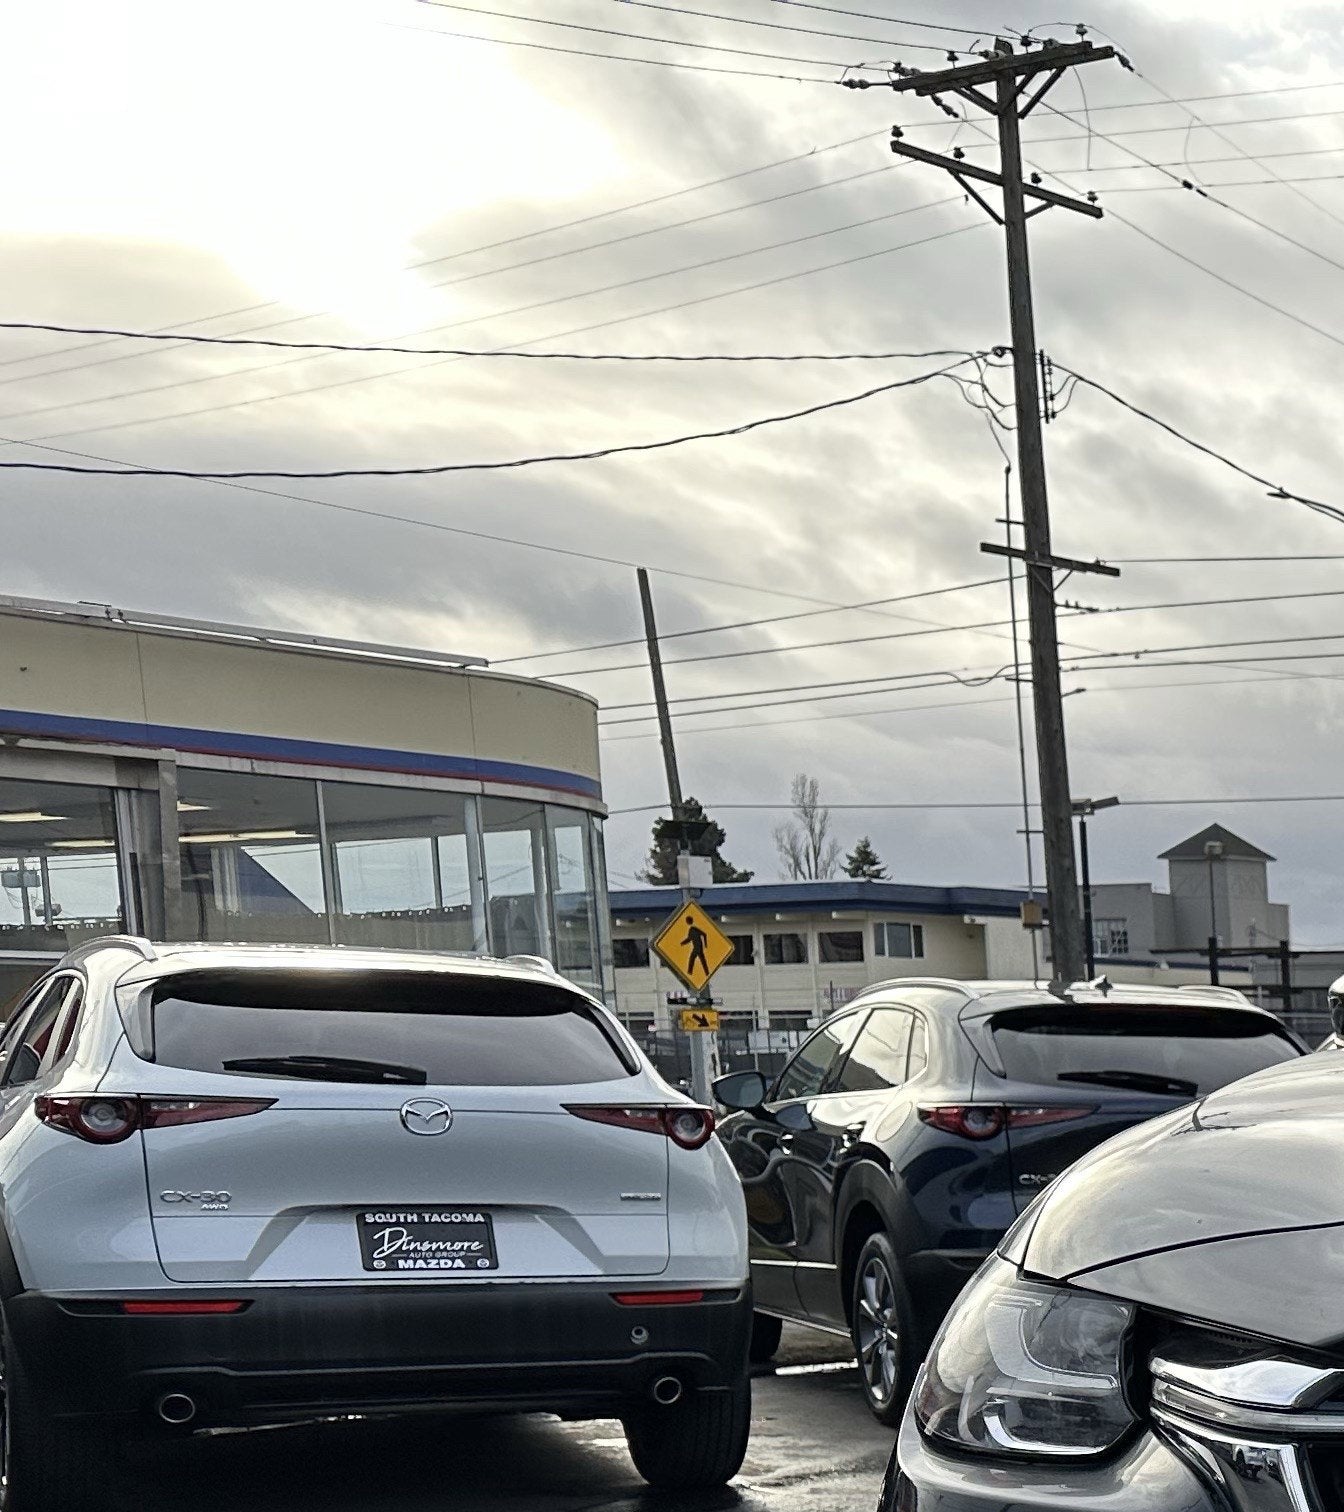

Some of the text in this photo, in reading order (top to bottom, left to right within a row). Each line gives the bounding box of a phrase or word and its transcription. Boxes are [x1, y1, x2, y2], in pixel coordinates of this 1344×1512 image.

[364, 1212, 485, 1223] SOUTH TACOMA
[372, 1226, 484, 1259] Dinsmore
[408, 1251, 433, 1259] AUTO
[397, 1258, 466, 1269] MAZDA
